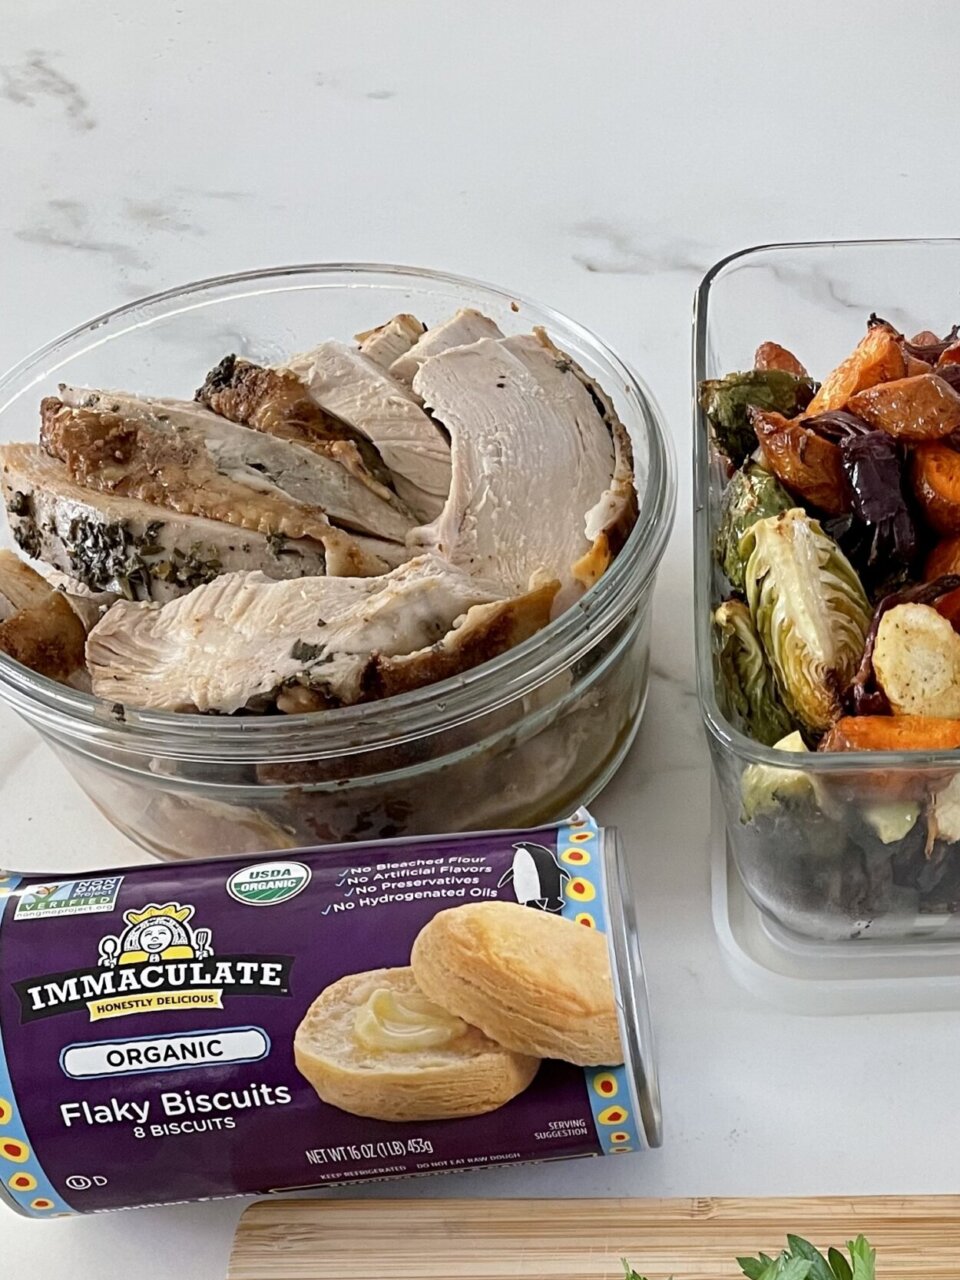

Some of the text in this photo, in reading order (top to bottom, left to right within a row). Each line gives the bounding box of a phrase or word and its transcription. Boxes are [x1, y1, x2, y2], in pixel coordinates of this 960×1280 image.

[249, 868, 292, 880] USDA
[351, 856, 487, 875] No Bleached Flour
[78, 878, 117, 887] NON
[347, 865, 493, 886] No Artificial Flavors
[73, 890, 112, 899] Project
[75, 885, 115, 893] GMO
[240, 879, 297, 892] ORGANIC
[355, 876, 480, 895] No Preservatives
[25, 896, 110, 911] VERIFIED
[333, 887, 498, 913] No Hydrogenated Oils
[16, 905, 113, 917] nongmoproject.org
[27, 962, 283, 1011] IMMACULATE
[97, 994, 216, 1014] HONESTLY DELICIOUS
[106, 1039, 224, 1068] ORGANIC
[60, 1083, 292, 1126] Flaky Biscuits
[133, 1116, 236, 1138] 8 BISCUITS
[534, 1127, 588, 1140] SUGGESTION
[548, 1118, 586, 1130] SERVING
[305, 1148, 329, 1165] NET
[327, 1146, 348, 1162] WT
[347, 1145, 362, 1160] 16
[360, 1143, 377, 1158] OZ
[389, 1141, 406, 1156] LB)
[407, 1138, 434, 1154] 453g
[344, 1165, 407, 1177] REFRIGERATED
[431, 1160, 448, 1168] NOT
[490, 1152, 521, 1161] DOUGH
